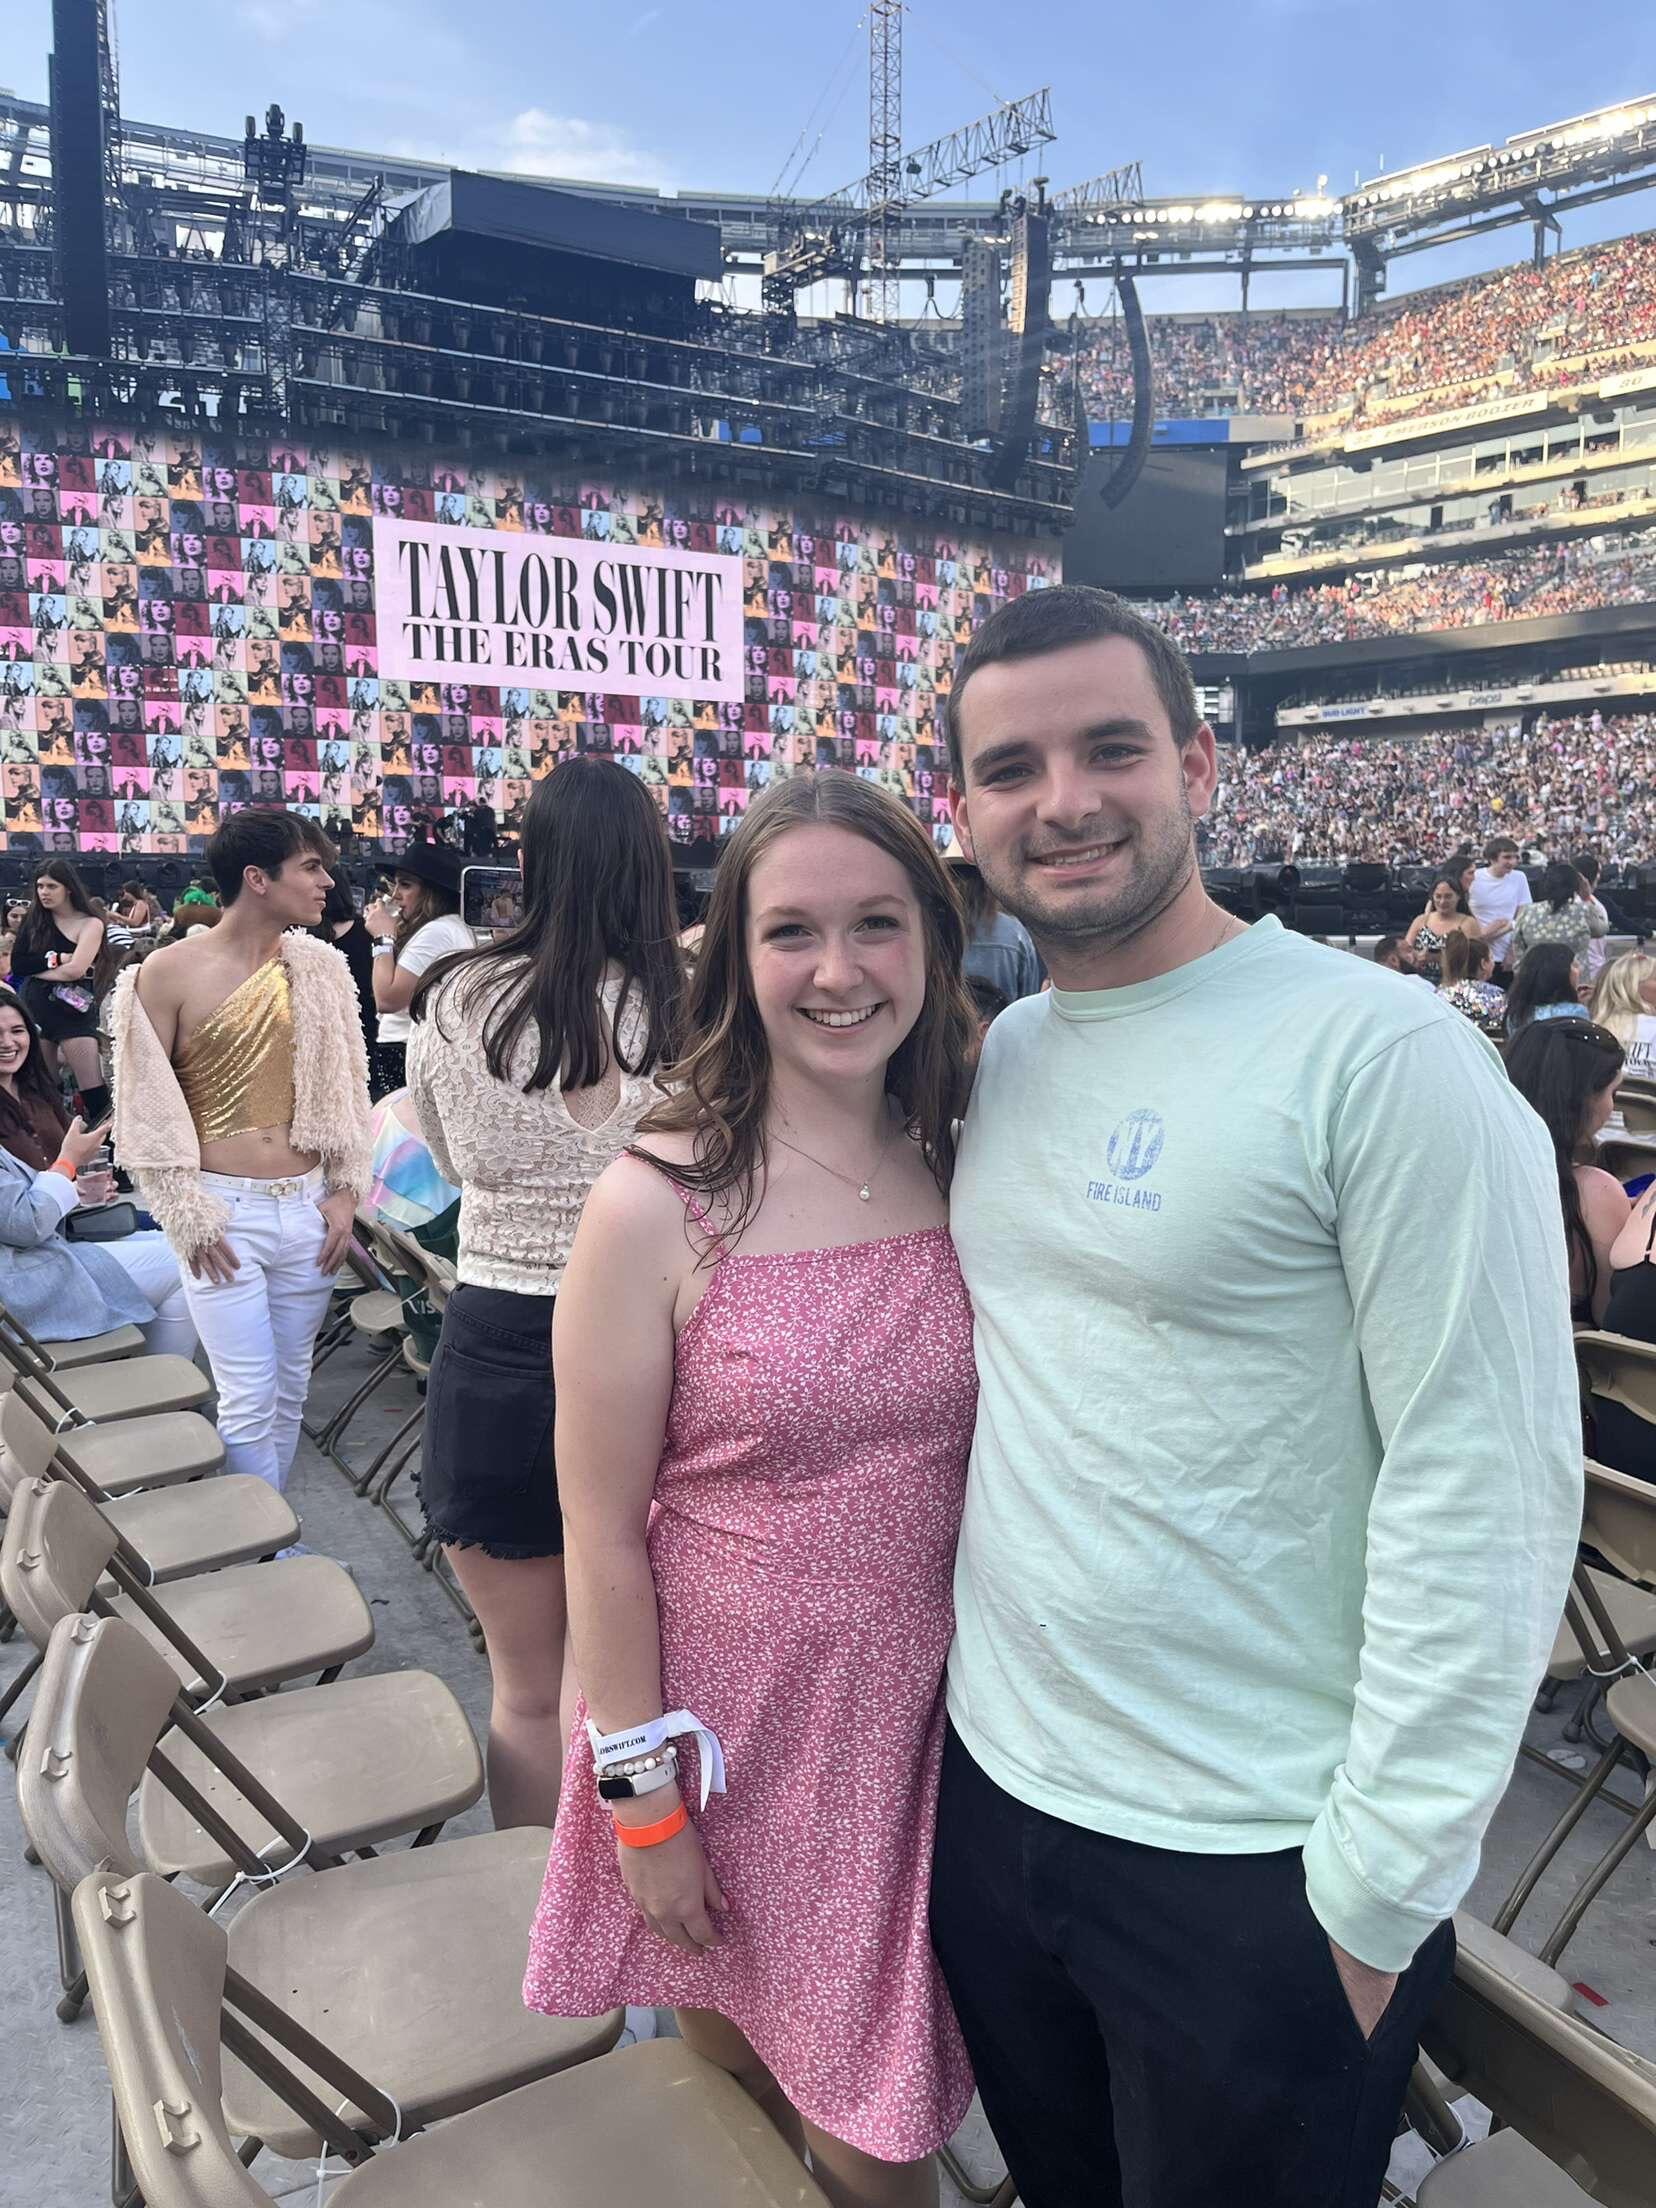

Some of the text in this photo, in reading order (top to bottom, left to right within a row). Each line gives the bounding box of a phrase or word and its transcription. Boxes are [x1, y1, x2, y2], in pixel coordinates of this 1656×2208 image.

[1466, 398, 1535, 420] BOOZER
[398, 540, 722, 643] TAYLOR SWIFT
[402, 622, 722, 682] THE ERAS TOUR
[1322, 706, 1365, 719] BUD LIGHT
[1087, 1181, 1162, 1212] FIRE ISLAND
